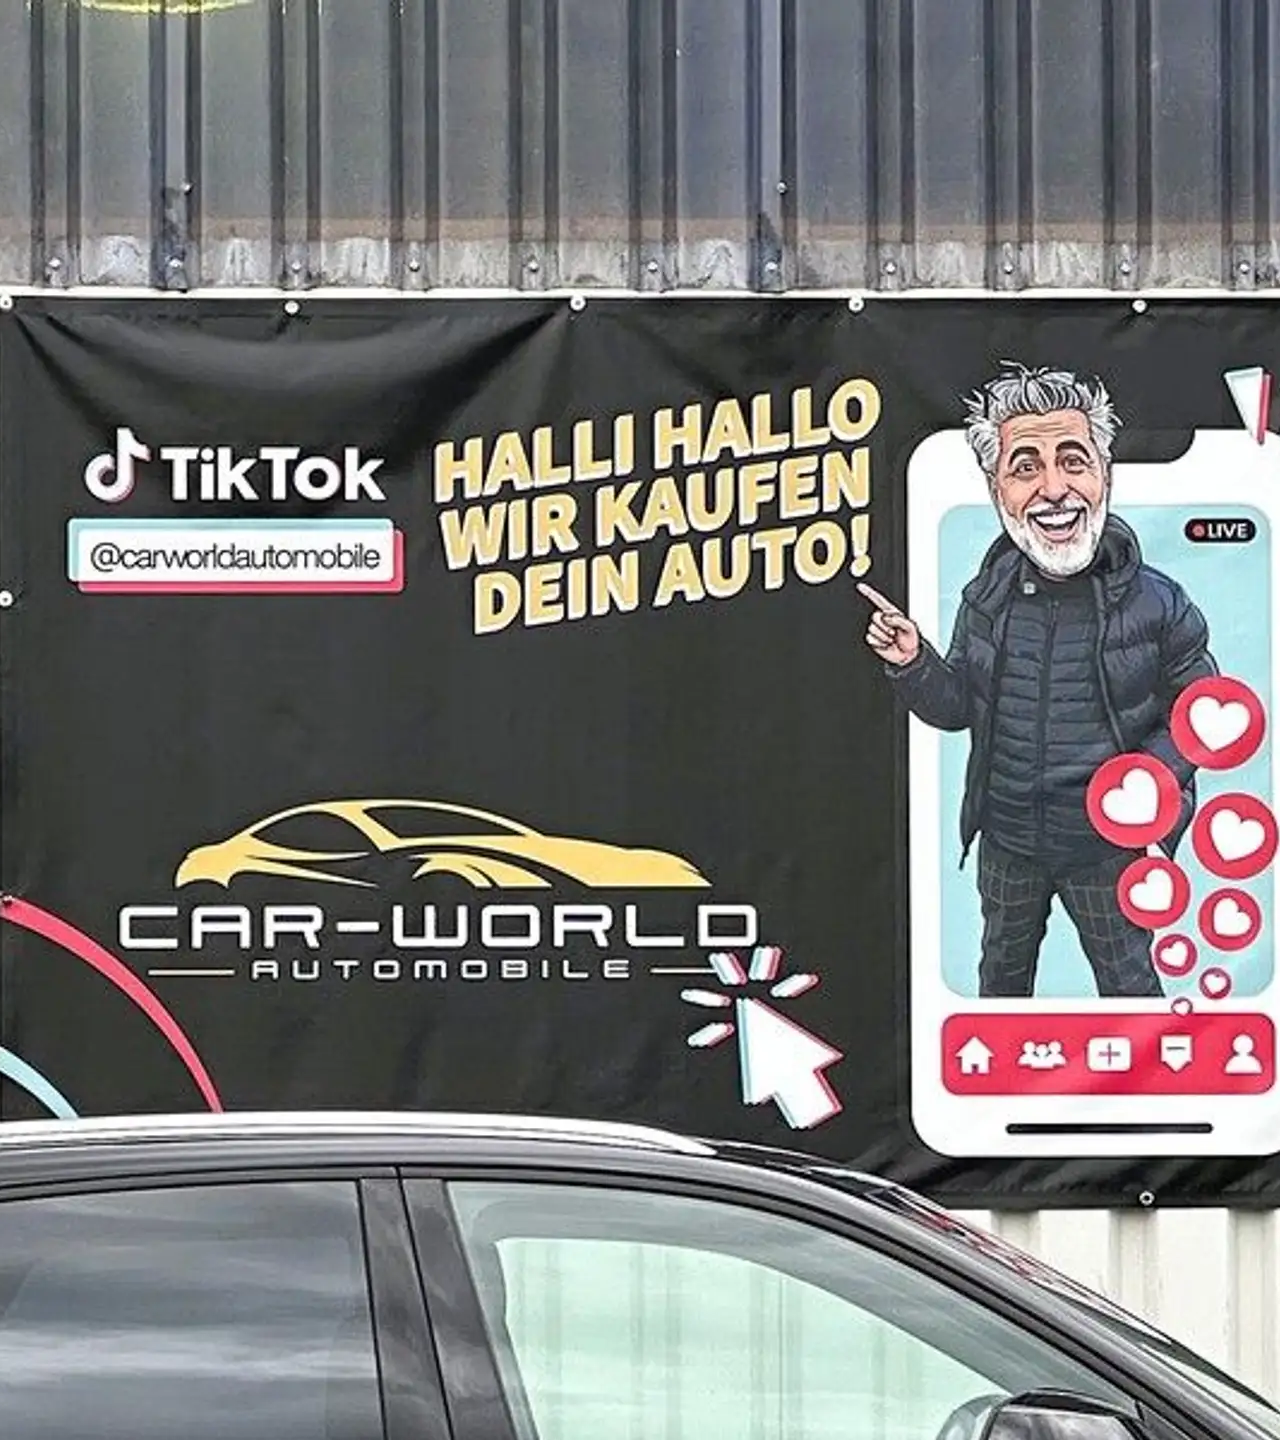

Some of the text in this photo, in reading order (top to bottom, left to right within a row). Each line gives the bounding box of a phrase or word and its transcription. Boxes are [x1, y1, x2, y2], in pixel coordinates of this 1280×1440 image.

[434, 377, 882, 505] HALLI HALLO
[160, 446, 387, 501] TikTok
[439, 445, 871, 570] WIR KAUFEN
[1208, 522, 1248, 539] LIVE
[90, 542, 381, 573] @carworldautomobile
[473, 512, 873, 636] DEIN AUTO!
[119, 904, 758, 950] CAR-WORLD
[251, 959, 631, 980] AUTOMOBILE
